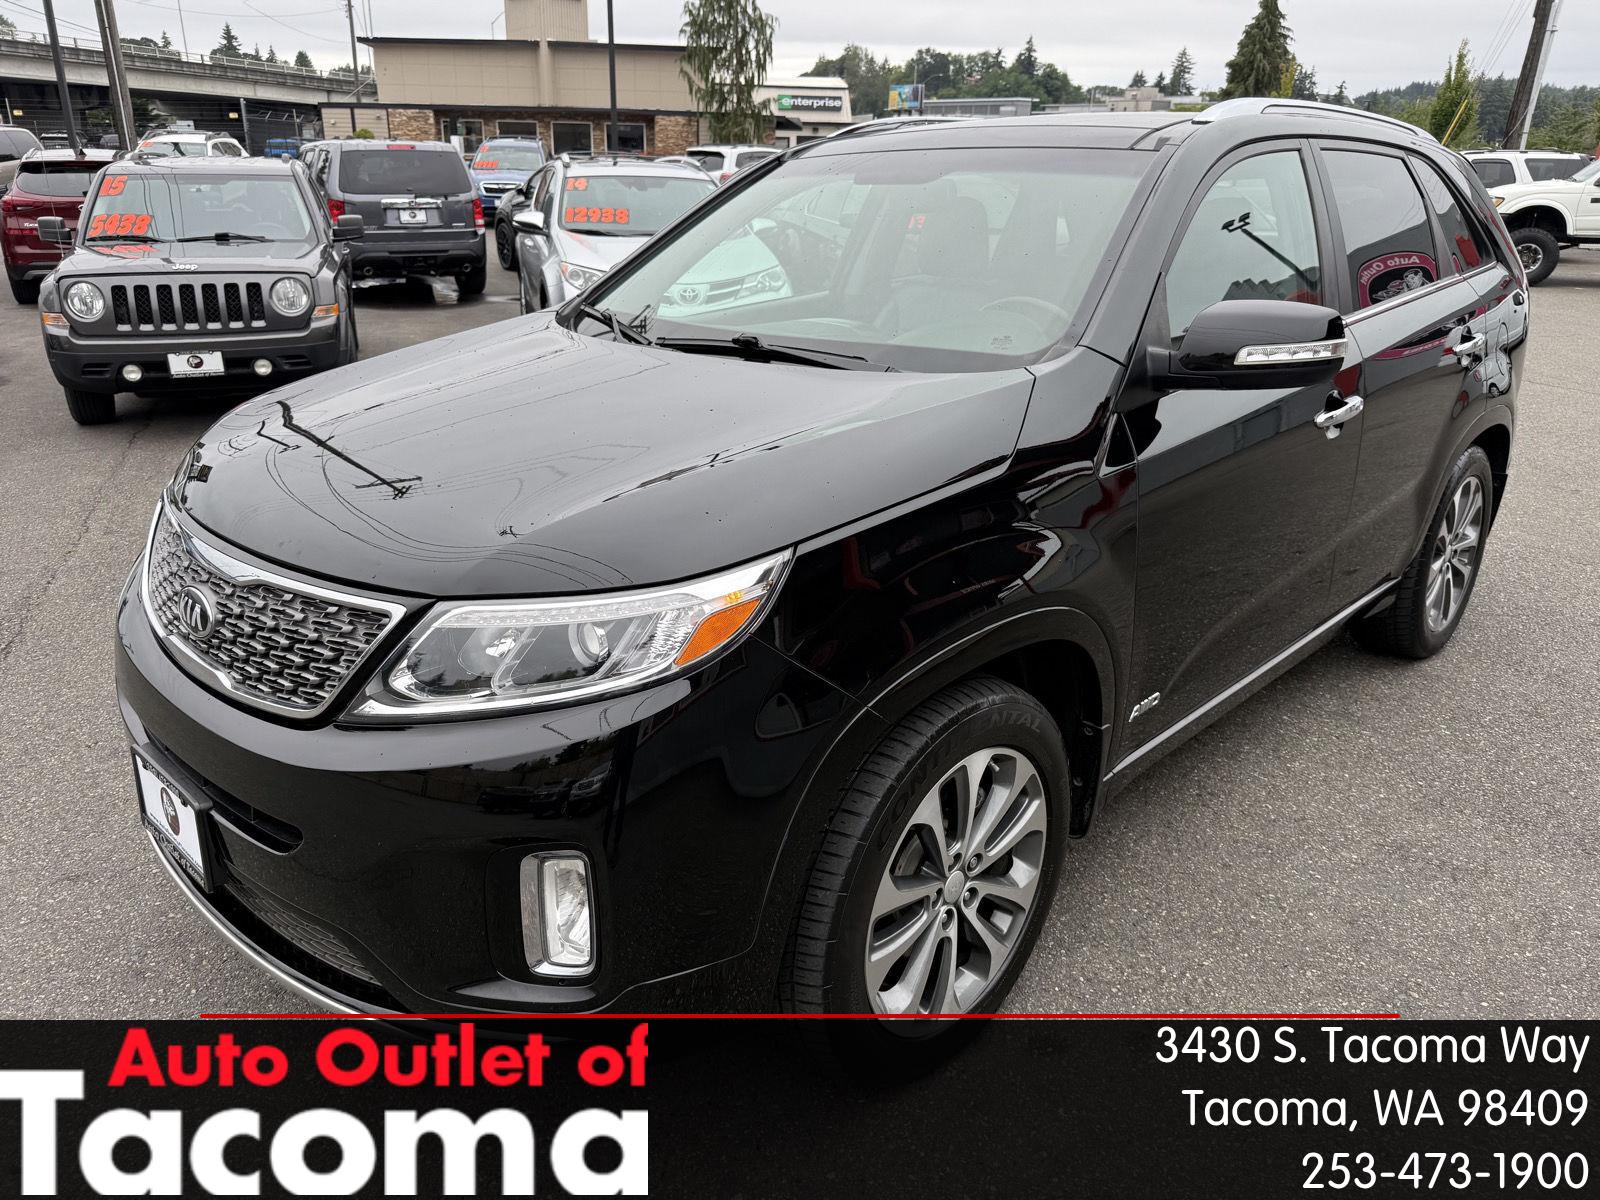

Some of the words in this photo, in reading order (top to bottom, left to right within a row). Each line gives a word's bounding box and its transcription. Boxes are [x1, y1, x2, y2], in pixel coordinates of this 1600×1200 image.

[780, 97, 842, 109] enterprise
[98, 175, 129, 196] 15
[566, 176, 588, 191] 14
[564, 206, 630, 225] 12938
[171, 263, 199, 271] Jeep
[180, 593, 203, 631] KIA
